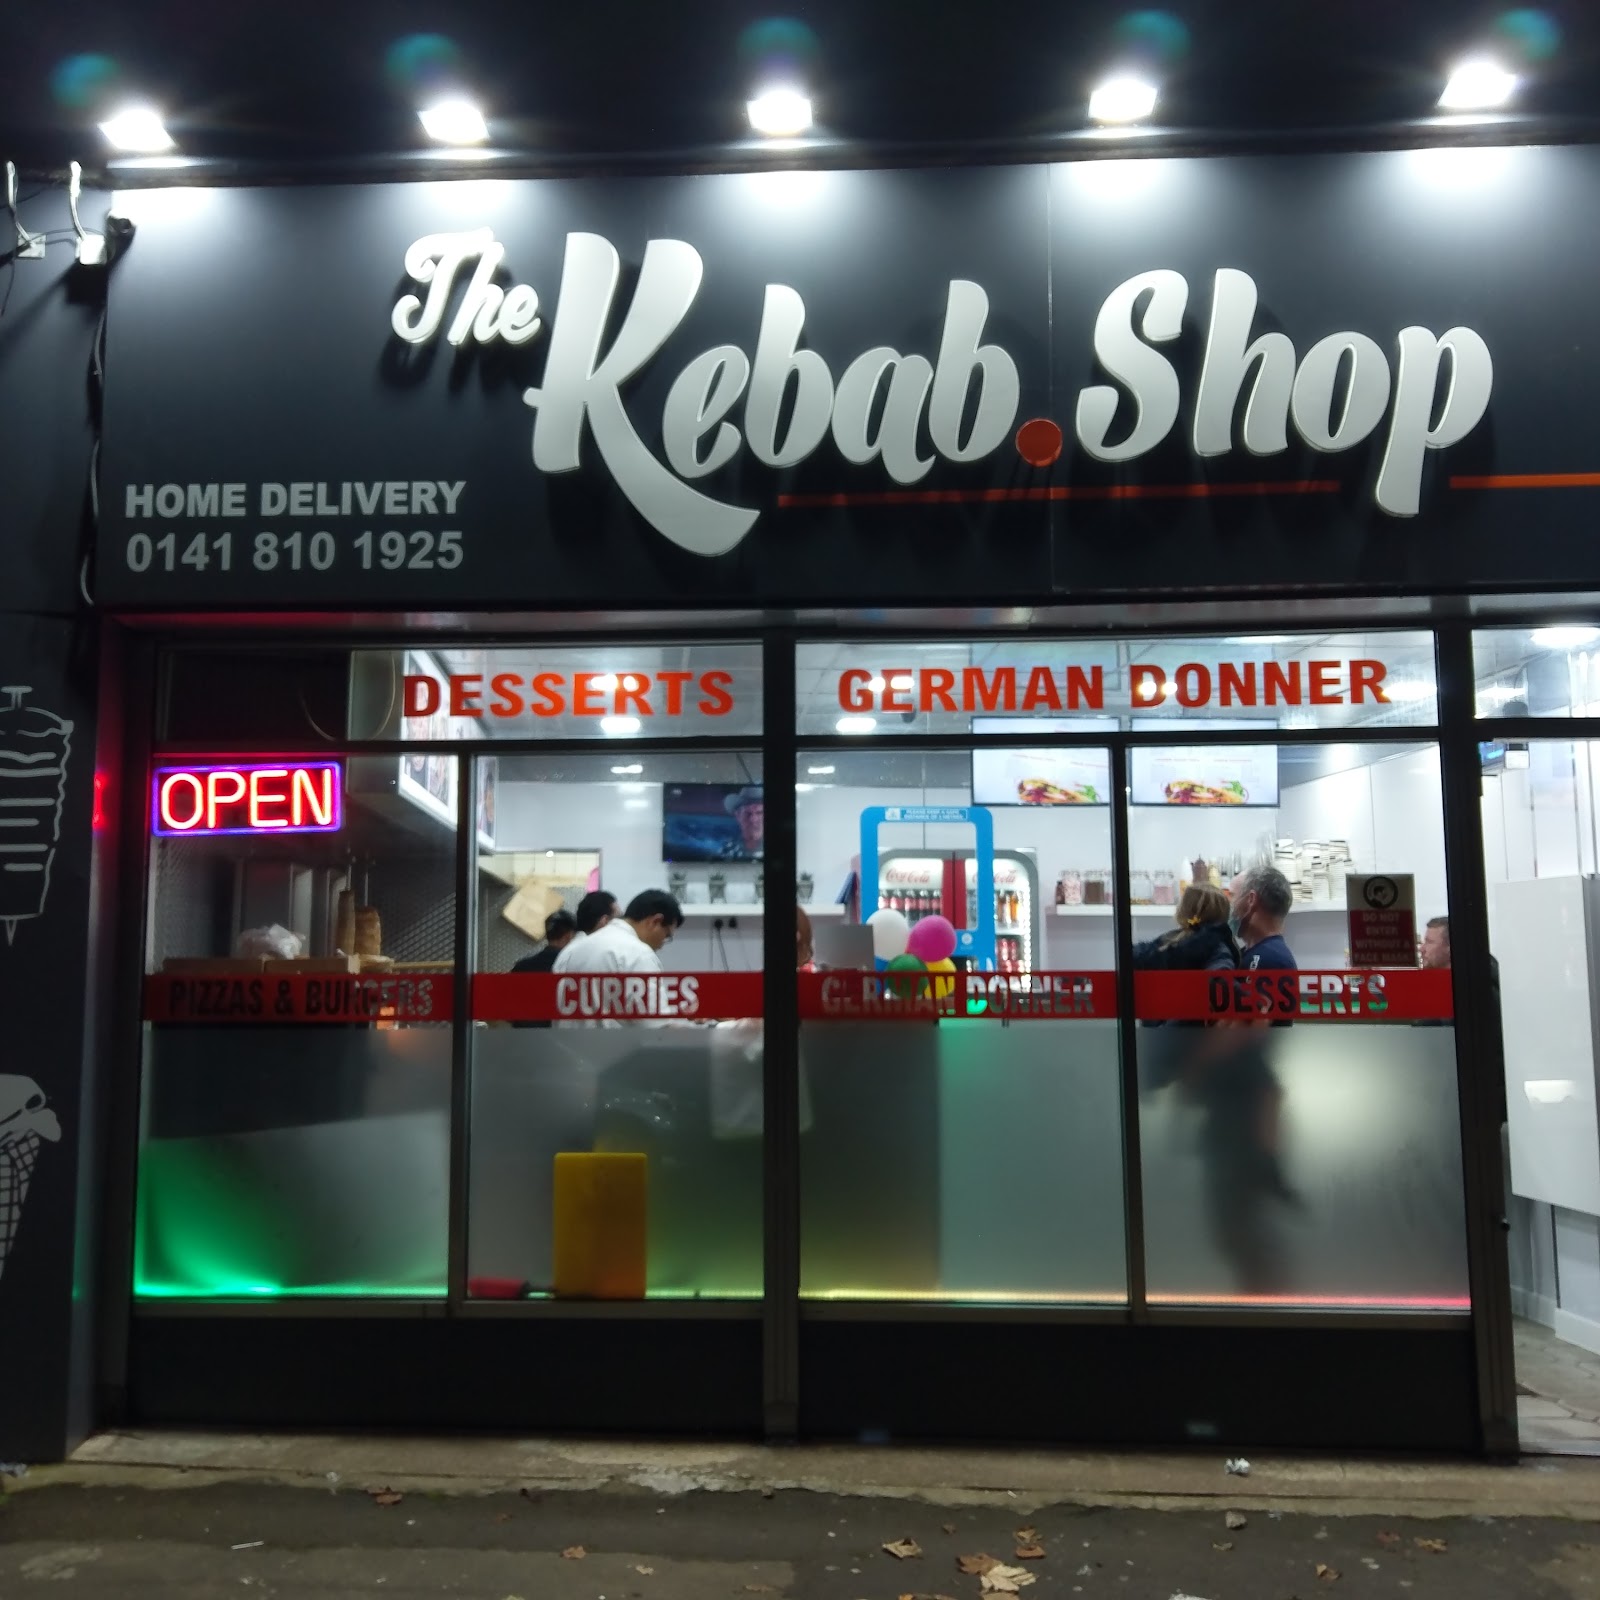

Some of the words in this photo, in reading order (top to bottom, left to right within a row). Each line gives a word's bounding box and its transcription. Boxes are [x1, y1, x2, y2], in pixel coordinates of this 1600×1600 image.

[391, 227, 541, 346] The
[125, 482, 247, 518] HOME
[260, 480, 467, 516] DELIVERY
[126, 532, 232, 572] 0141
[252, 531, 336, 571] 810
[353, 530, 464, 570] 1925
[403, 670, 735, 718] DESSERTS
[838, 665, 1104, 713] GERMAN
[1129, 659, 1392, 708] DONNER
[160, 768, 333, 830] OPEN
[171, 979, 264, 1017] PIZZAS
[274, 979, 295, 1015] &
[305, 978, 434, 1016] BURGERS
[556, 976, 700, 1016] CURRIES
[821, 975, 955, 1015] GERMAN
[966, 975, 1095, 1015] DONNER
[1208, 974, 1389, 1015] DESSERTS
